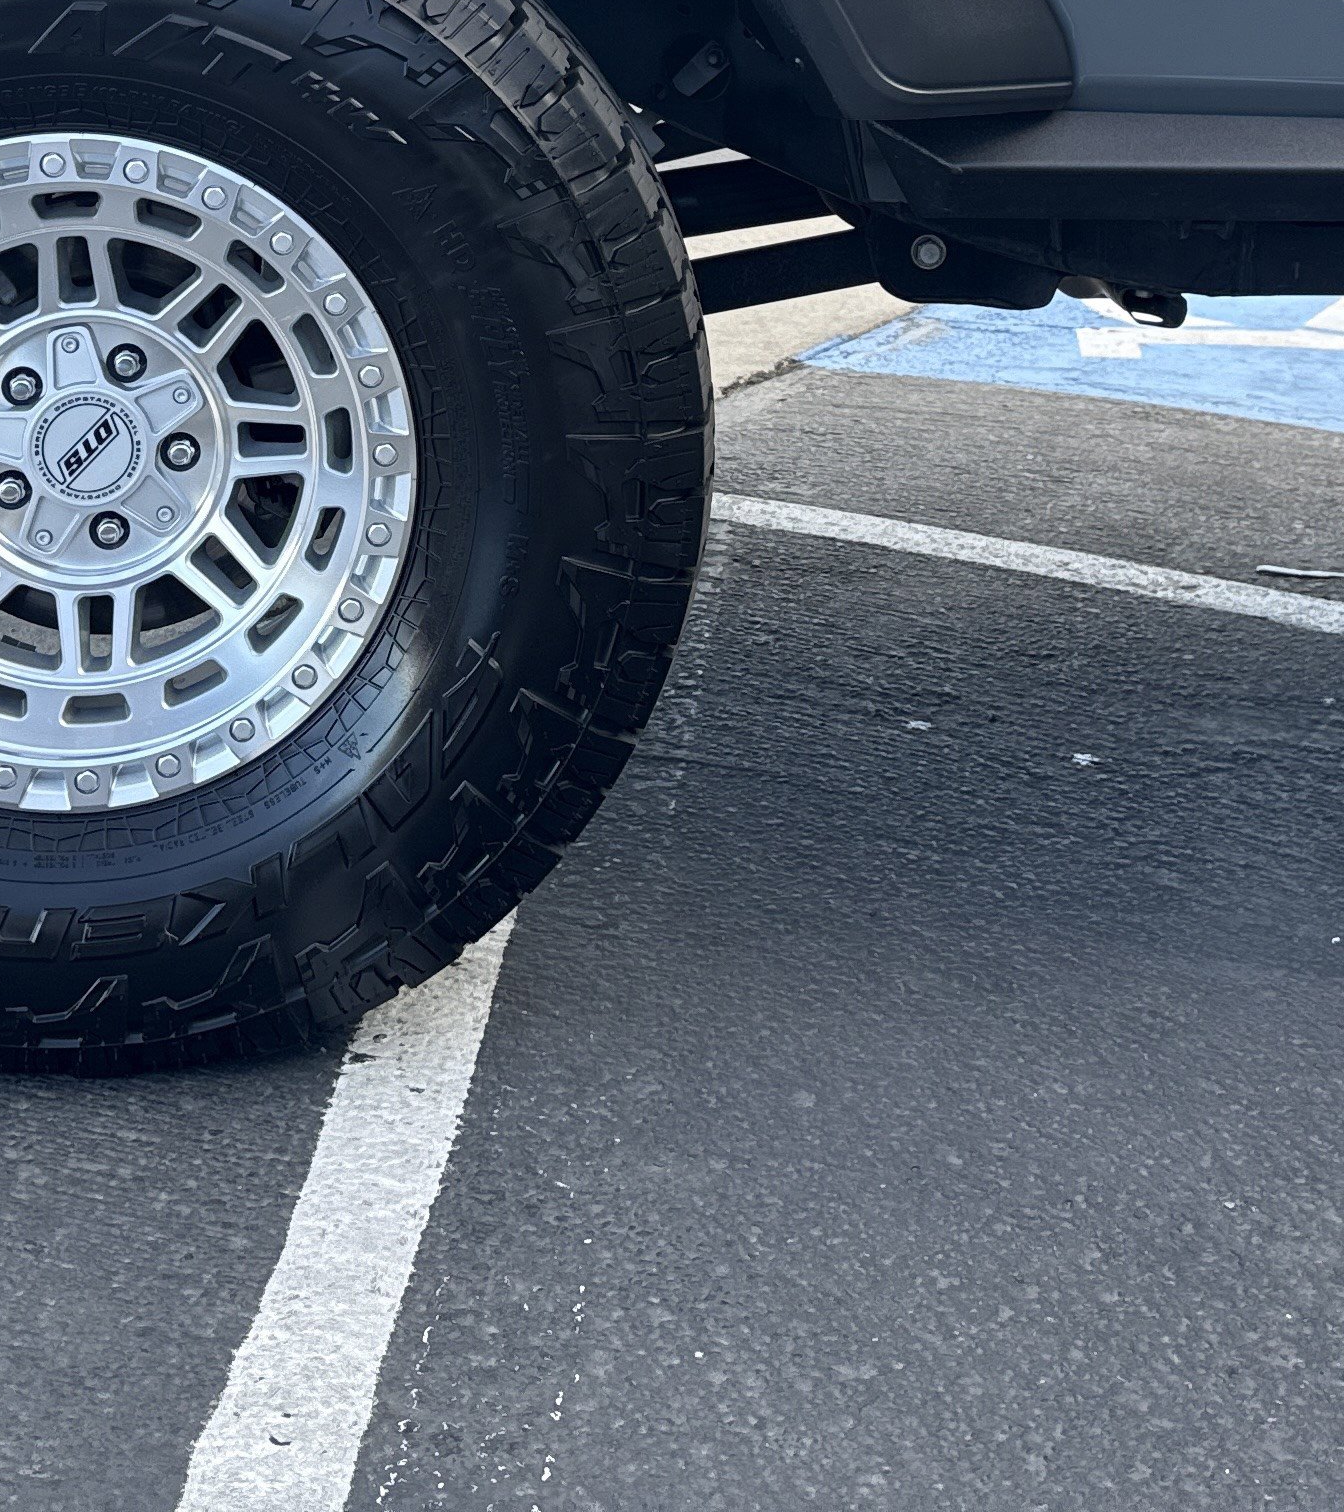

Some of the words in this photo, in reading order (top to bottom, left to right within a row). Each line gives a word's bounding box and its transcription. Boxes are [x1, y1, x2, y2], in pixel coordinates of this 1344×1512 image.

[54, 396, 116, 412] DROPSTARS
[119, 408, 138, 436] TRAIL
[127, 440, 141, 478] SERIES
